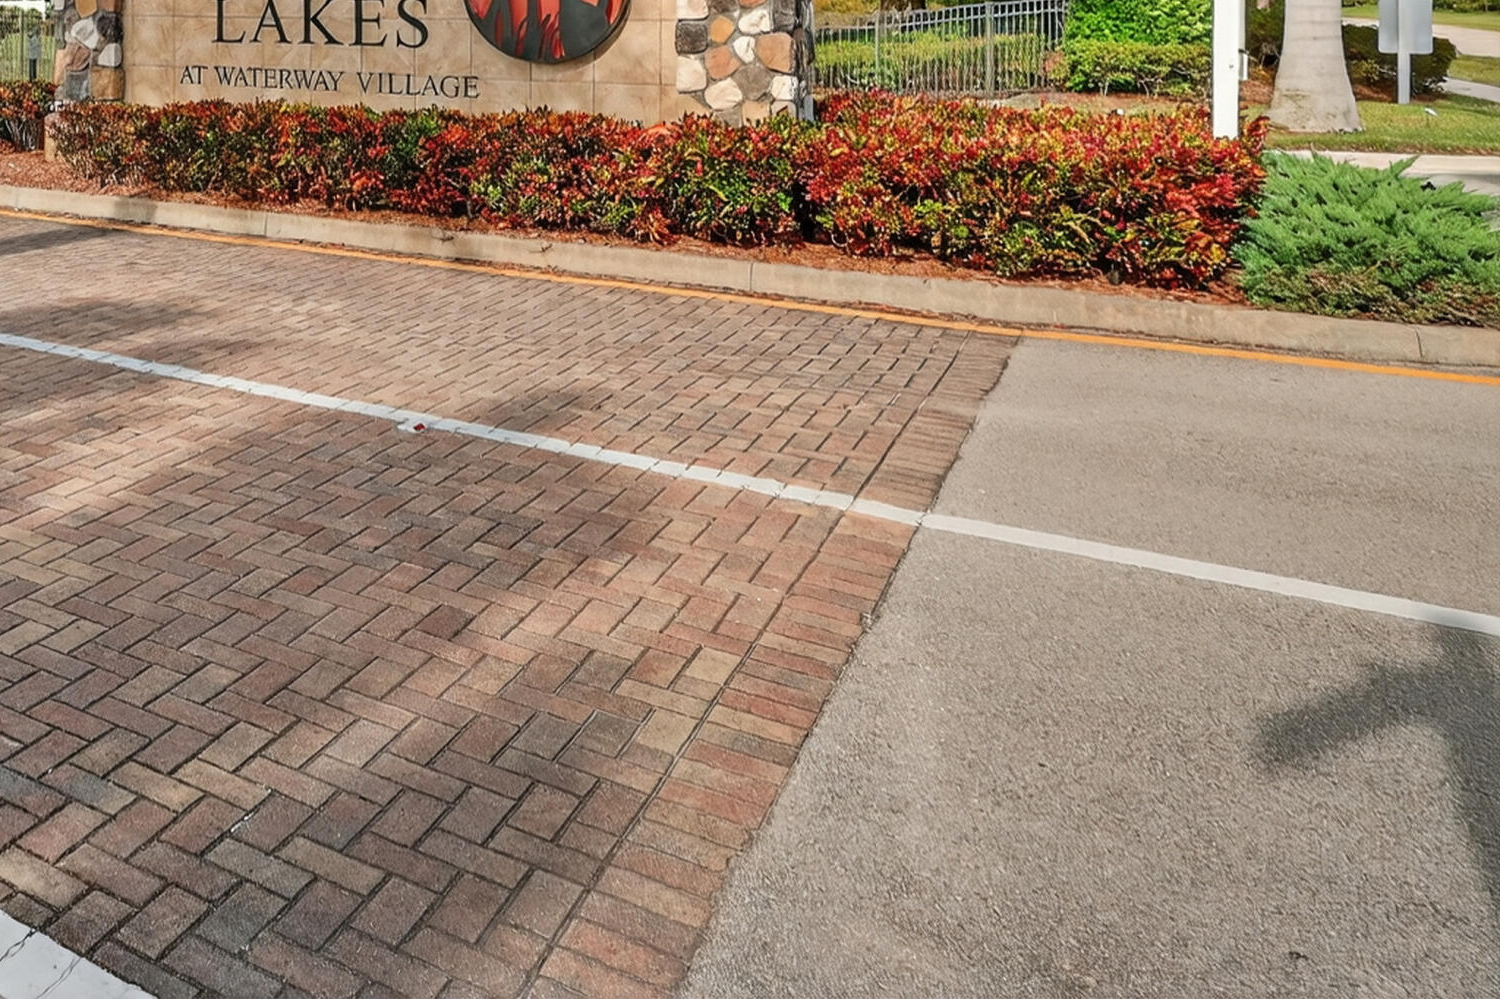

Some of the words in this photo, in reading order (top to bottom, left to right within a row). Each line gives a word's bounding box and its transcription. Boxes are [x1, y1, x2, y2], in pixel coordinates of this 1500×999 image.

[180, 65, 208, 85] AT
[213, 66, 345, 91] WATERWAY
[356, 72, 479, 98] VILLAGE
